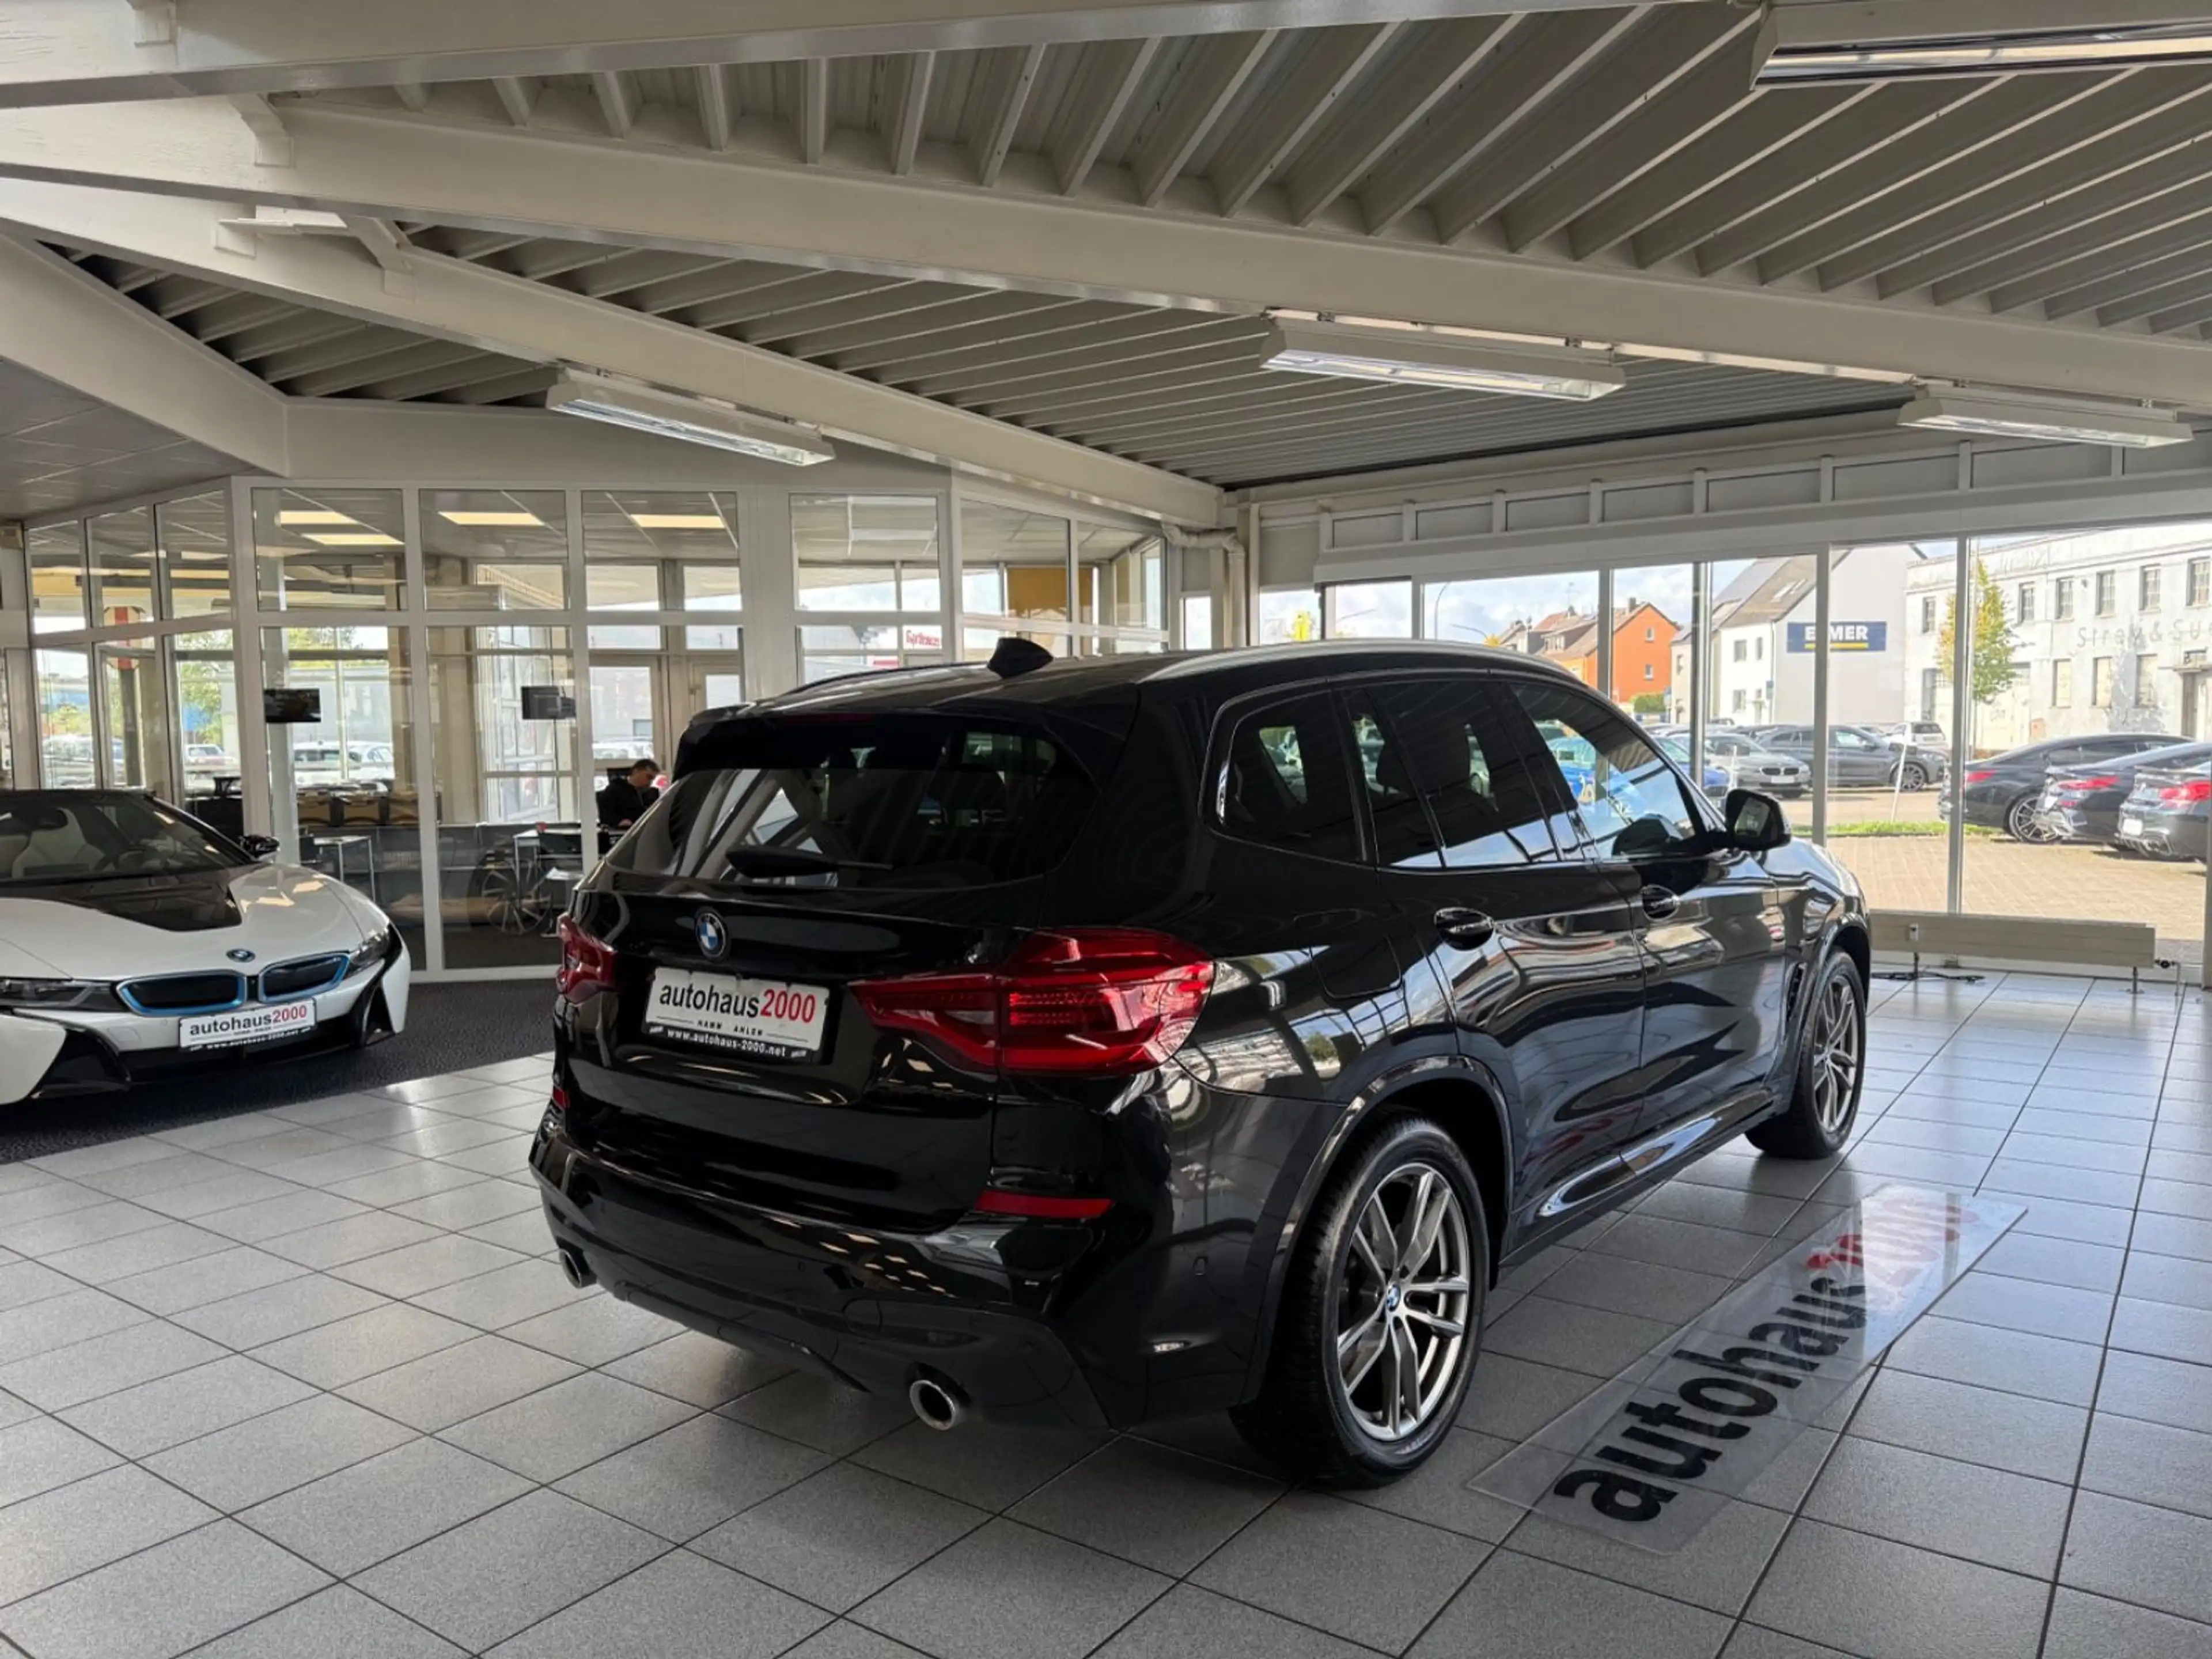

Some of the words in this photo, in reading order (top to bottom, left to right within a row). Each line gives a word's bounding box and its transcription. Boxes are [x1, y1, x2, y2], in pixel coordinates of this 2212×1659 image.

[1804, 624, 1868, 641] EMER
[660, 983, 816, 1023] autohaus2000
[190, 1005, 306, 1035] autohaus2000
